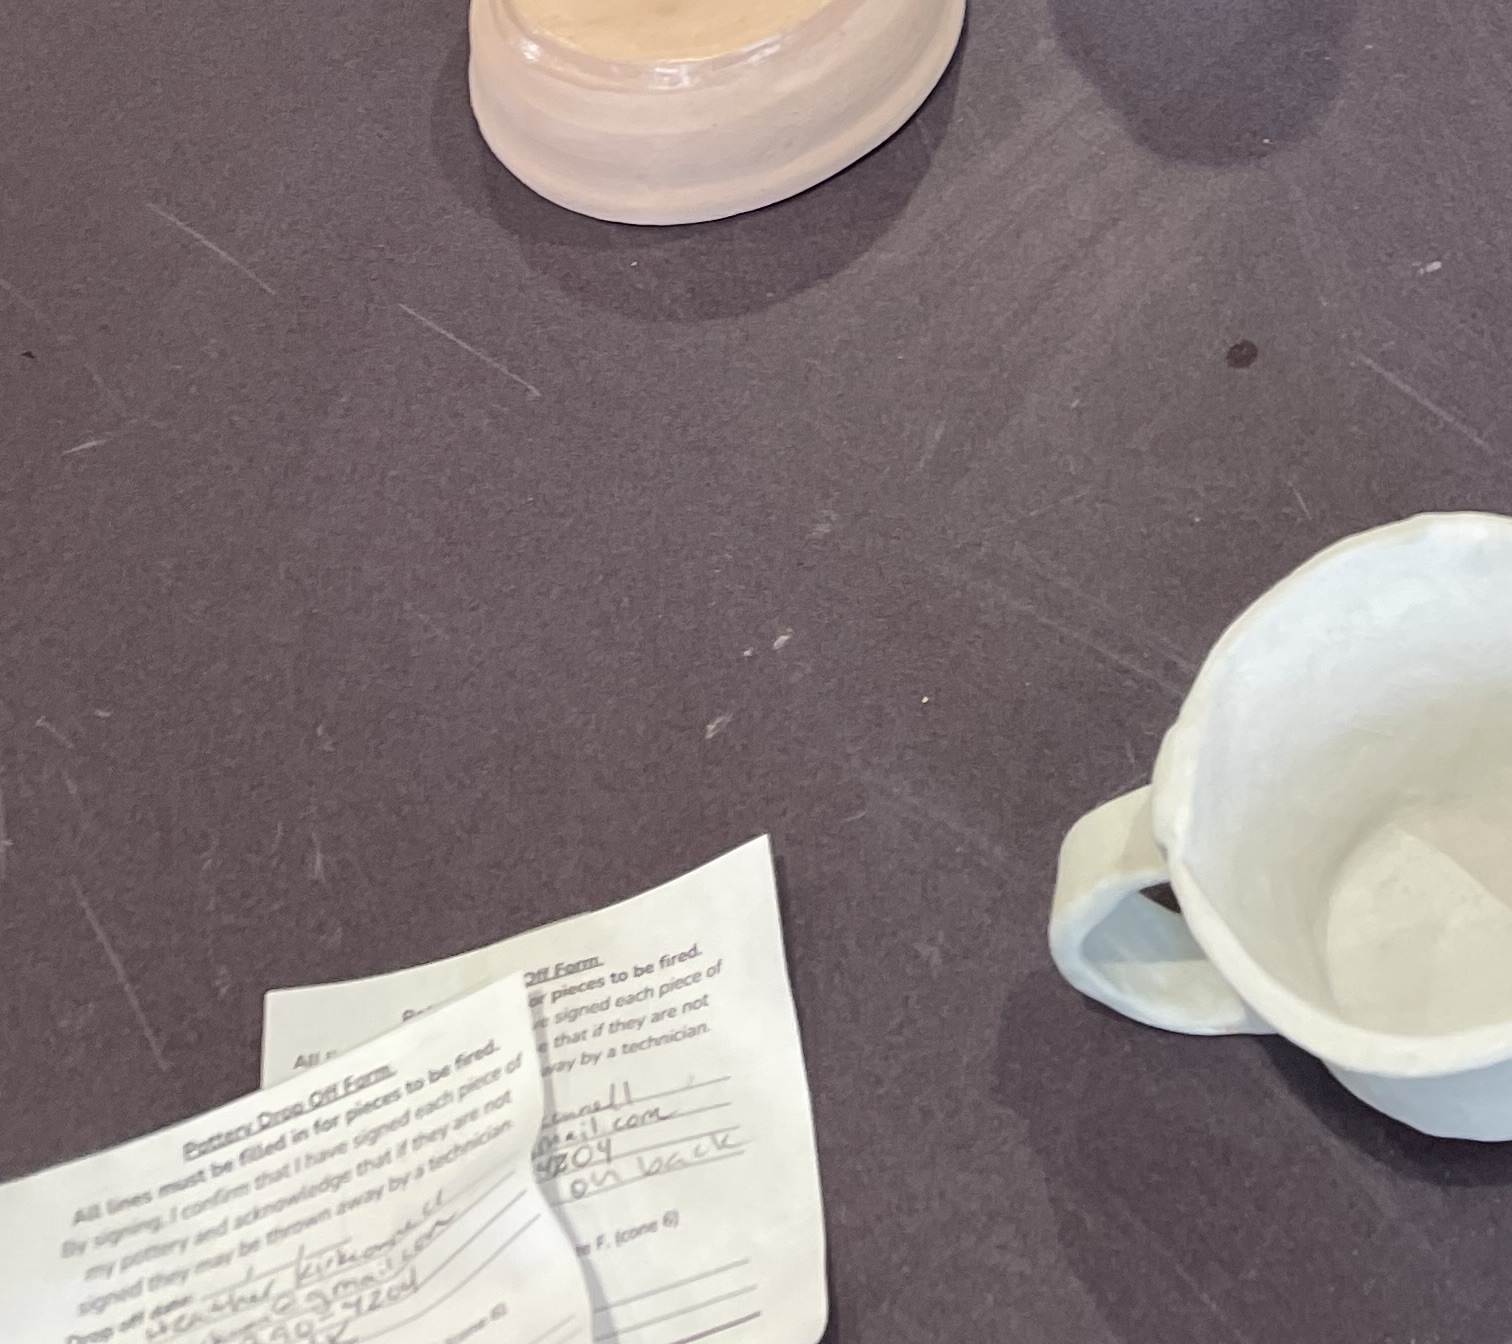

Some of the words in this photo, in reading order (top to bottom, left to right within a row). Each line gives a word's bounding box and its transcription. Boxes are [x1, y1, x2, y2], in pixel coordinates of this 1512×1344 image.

[550, 975, 605, 1004] pieces
[609, 969, 629, 985] to
[633, 963, 655, 979] be
[658, 943, 703, 970] fired.
[554, 995, 611, 1024] signed
[614, 987, 655, 1008] each
[658, 970, 702, 999] piece
[705, 958, 723, 978] of
[553, 1028, 588, 1050] that
[592, 1023, 605, 1039] if
[608, 1014, 647, 1042] they
[650, 1006, 677, 1024] are
[681, 993, 710, 1014] not
[579, 1050, 602, 1067] by
[606, 1047, 617, 1059] a
[621, 1021, 712, 1056] technician.
[345, 1086, 402, 1127] pieces
[404, 1077, 425, 1095] to
[428, 1064, 452, 1084] be
[454, 1039, 500, 1069] fired.
[182, 1122, 254, 1163] Pottery
